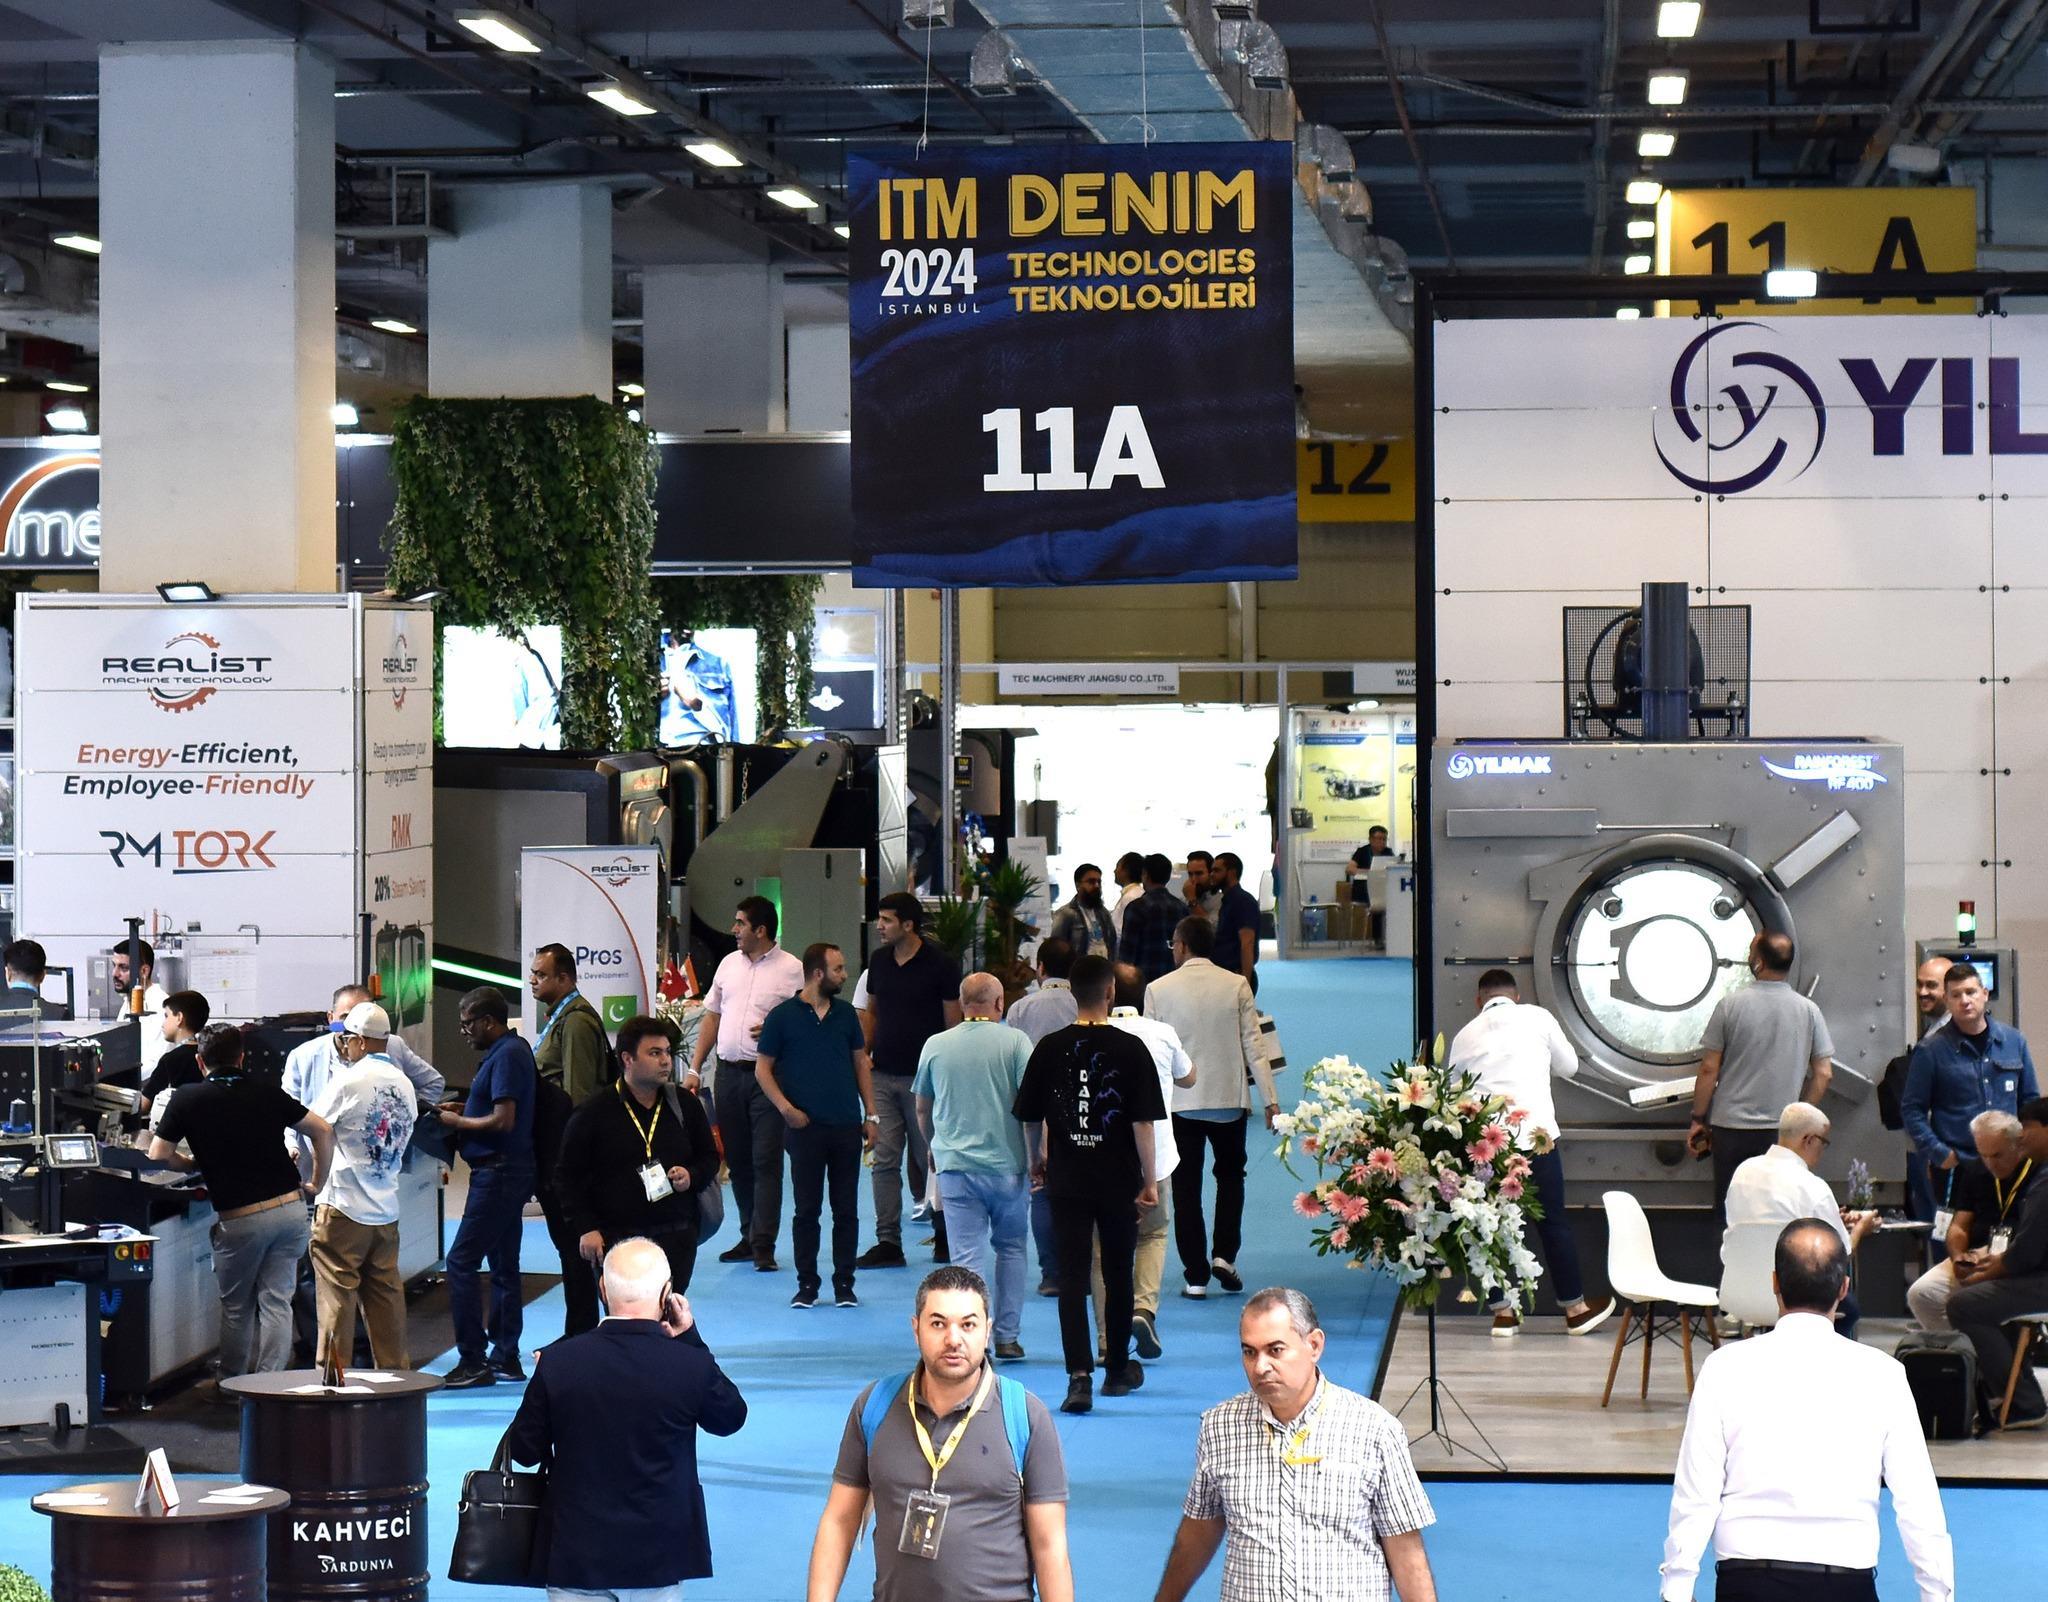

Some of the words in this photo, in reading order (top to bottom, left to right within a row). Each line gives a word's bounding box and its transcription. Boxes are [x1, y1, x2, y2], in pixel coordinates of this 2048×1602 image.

[879, 178, 977, 240] ITM
[1008, 170, 1255, 237] DENIM
[880, 248, 978, 297] 2024
[1007, 248, 1256, 278] TECHNOLOGIES
[1863, 217, 1936, 304] A
[1008, 277, 1256, 312] TEKNOLOJİLERİ
[982, 405, 1166, 491] 11A
[1306, 442, 1391, 494] 12
[1012, 674, 1030, 683] TEC
[1032, 674, 1086, 683] MACHINERY
[1087, 674, 1127, 683] JIANGSU
[77, 742, 299, 769] Energy-Efficient,
[63, 773, 315, 800] Employee-Friendly
[391, 813, 412, 849] RMK
[172, 831, 277, 868] TORK
[293, 1509, 410, 1542] KAHVECİ
